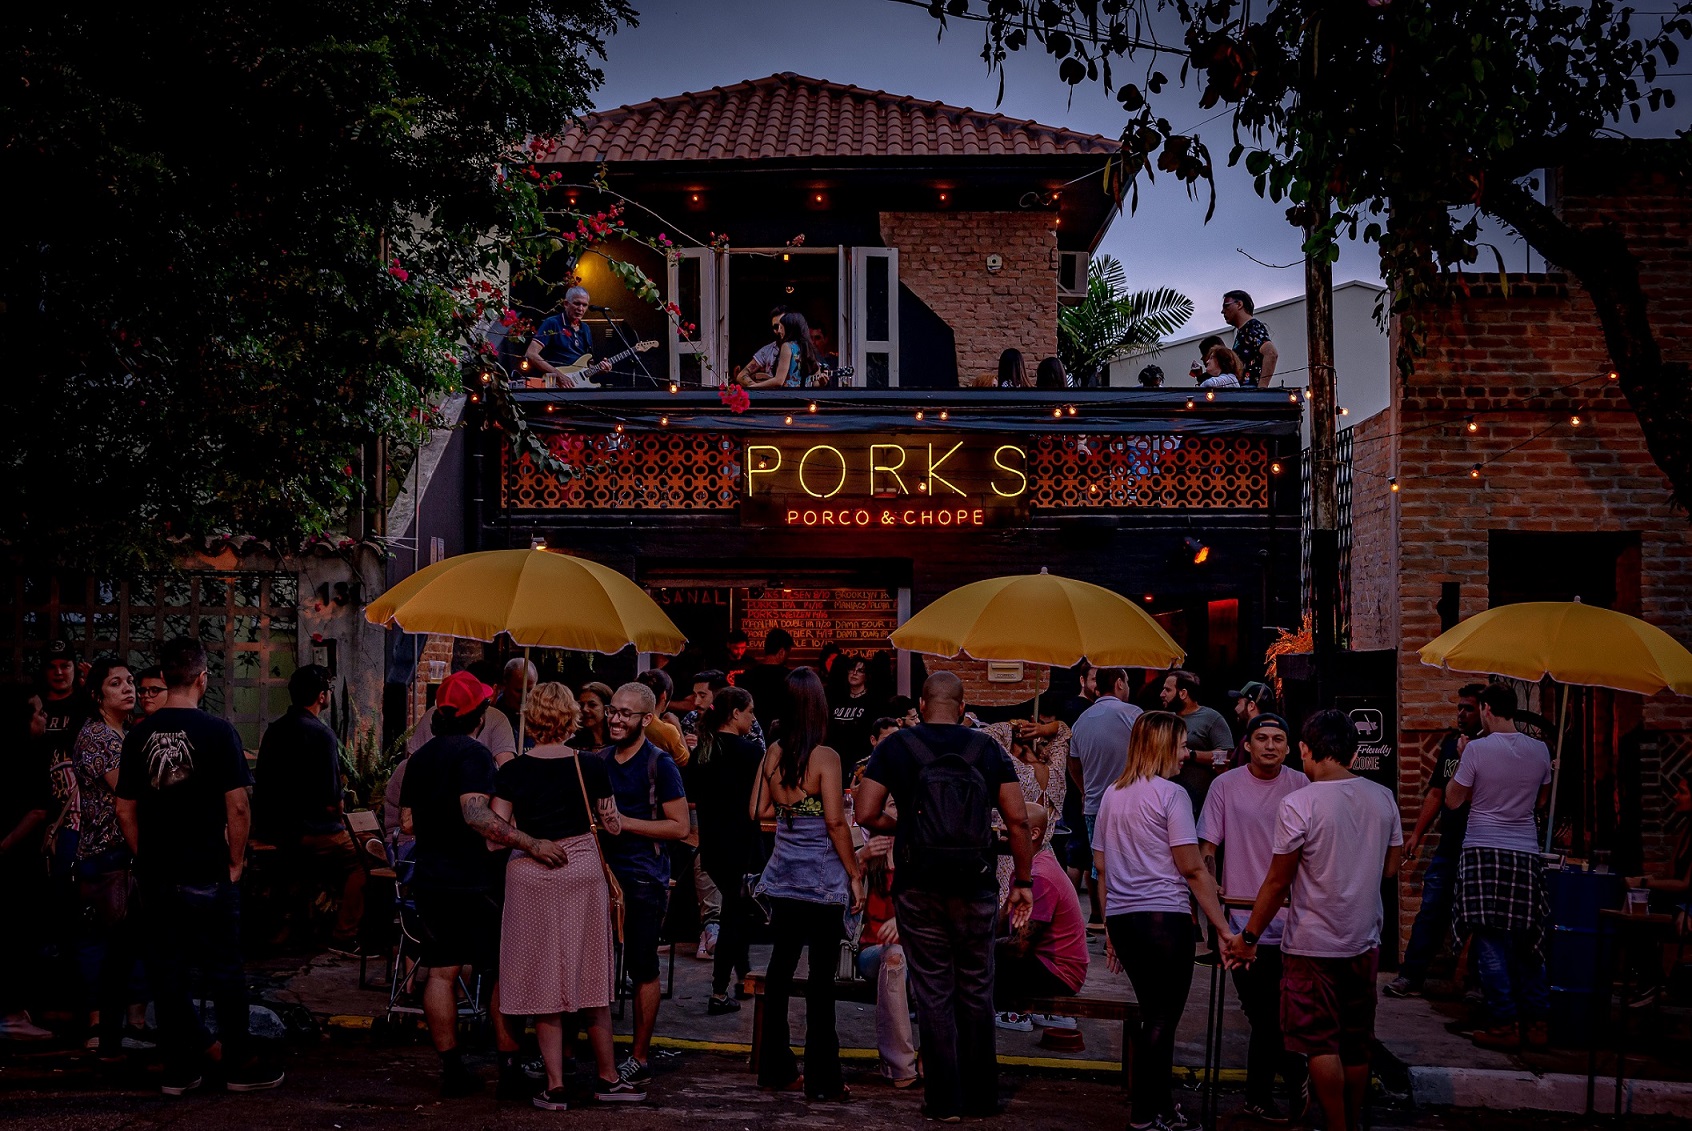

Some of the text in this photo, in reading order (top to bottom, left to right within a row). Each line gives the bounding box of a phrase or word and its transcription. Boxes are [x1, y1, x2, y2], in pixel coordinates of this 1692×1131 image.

[748, 441, 1027, 498] PORKS
[787, 510, 983, 525] PORCO & CHOPE
[835, 591, 877, 599] BROOKLYN
[747, 601, 778, 609] PORKS
[783, 601, 796, 609] IPA
[748, 610, 779, 618] PORKS
[836, 620, 859, 629] DAMA
[862, 620, 885, 628] SOUR
[836, 630, 858, 638] DAMA
[833, 706, 865, 718] PORKS
[1356, 744, 1392, 757] Friendly
[1352, 756, 1380, 770] ZONE
